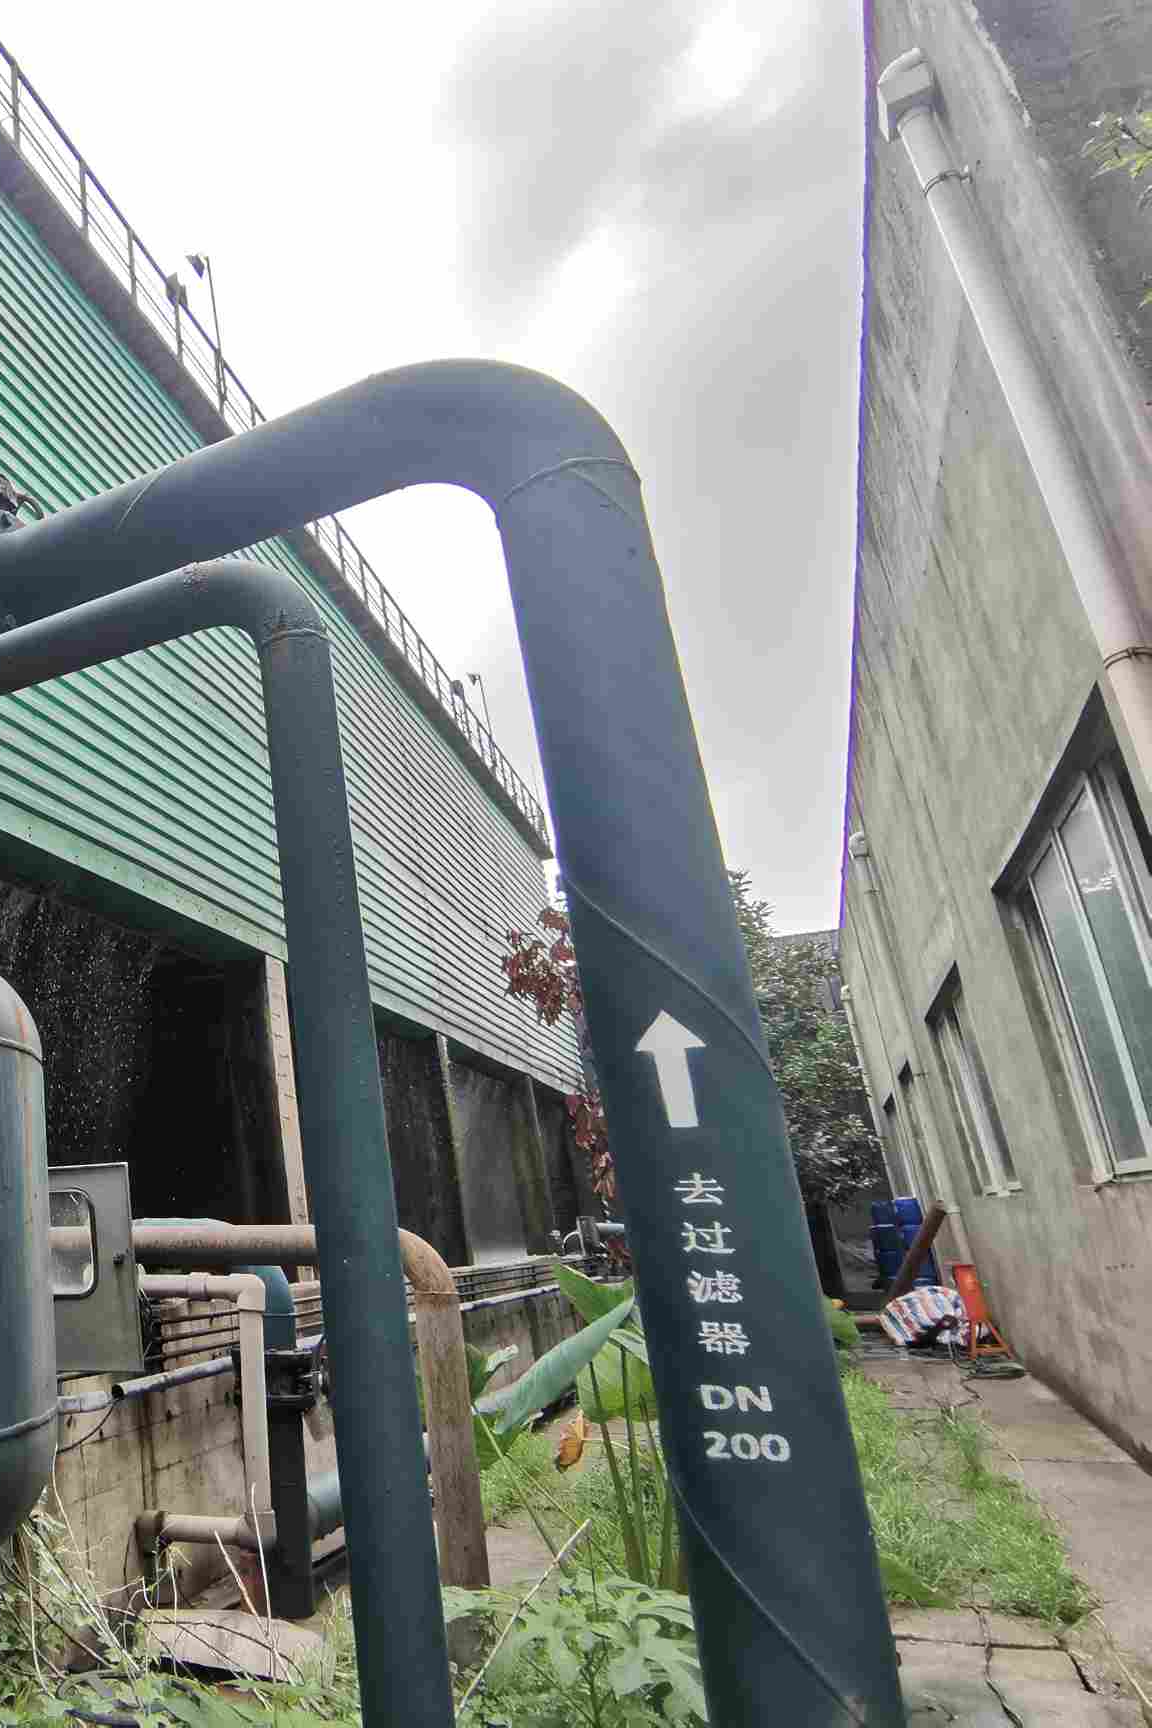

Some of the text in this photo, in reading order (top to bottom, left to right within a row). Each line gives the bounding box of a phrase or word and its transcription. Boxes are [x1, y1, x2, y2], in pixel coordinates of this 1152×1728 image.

[673, 1172, 751, 1356] 去过滤器
[700, 1384, 773, 1413] DN
[703, 1431, 791, 1462] 200
